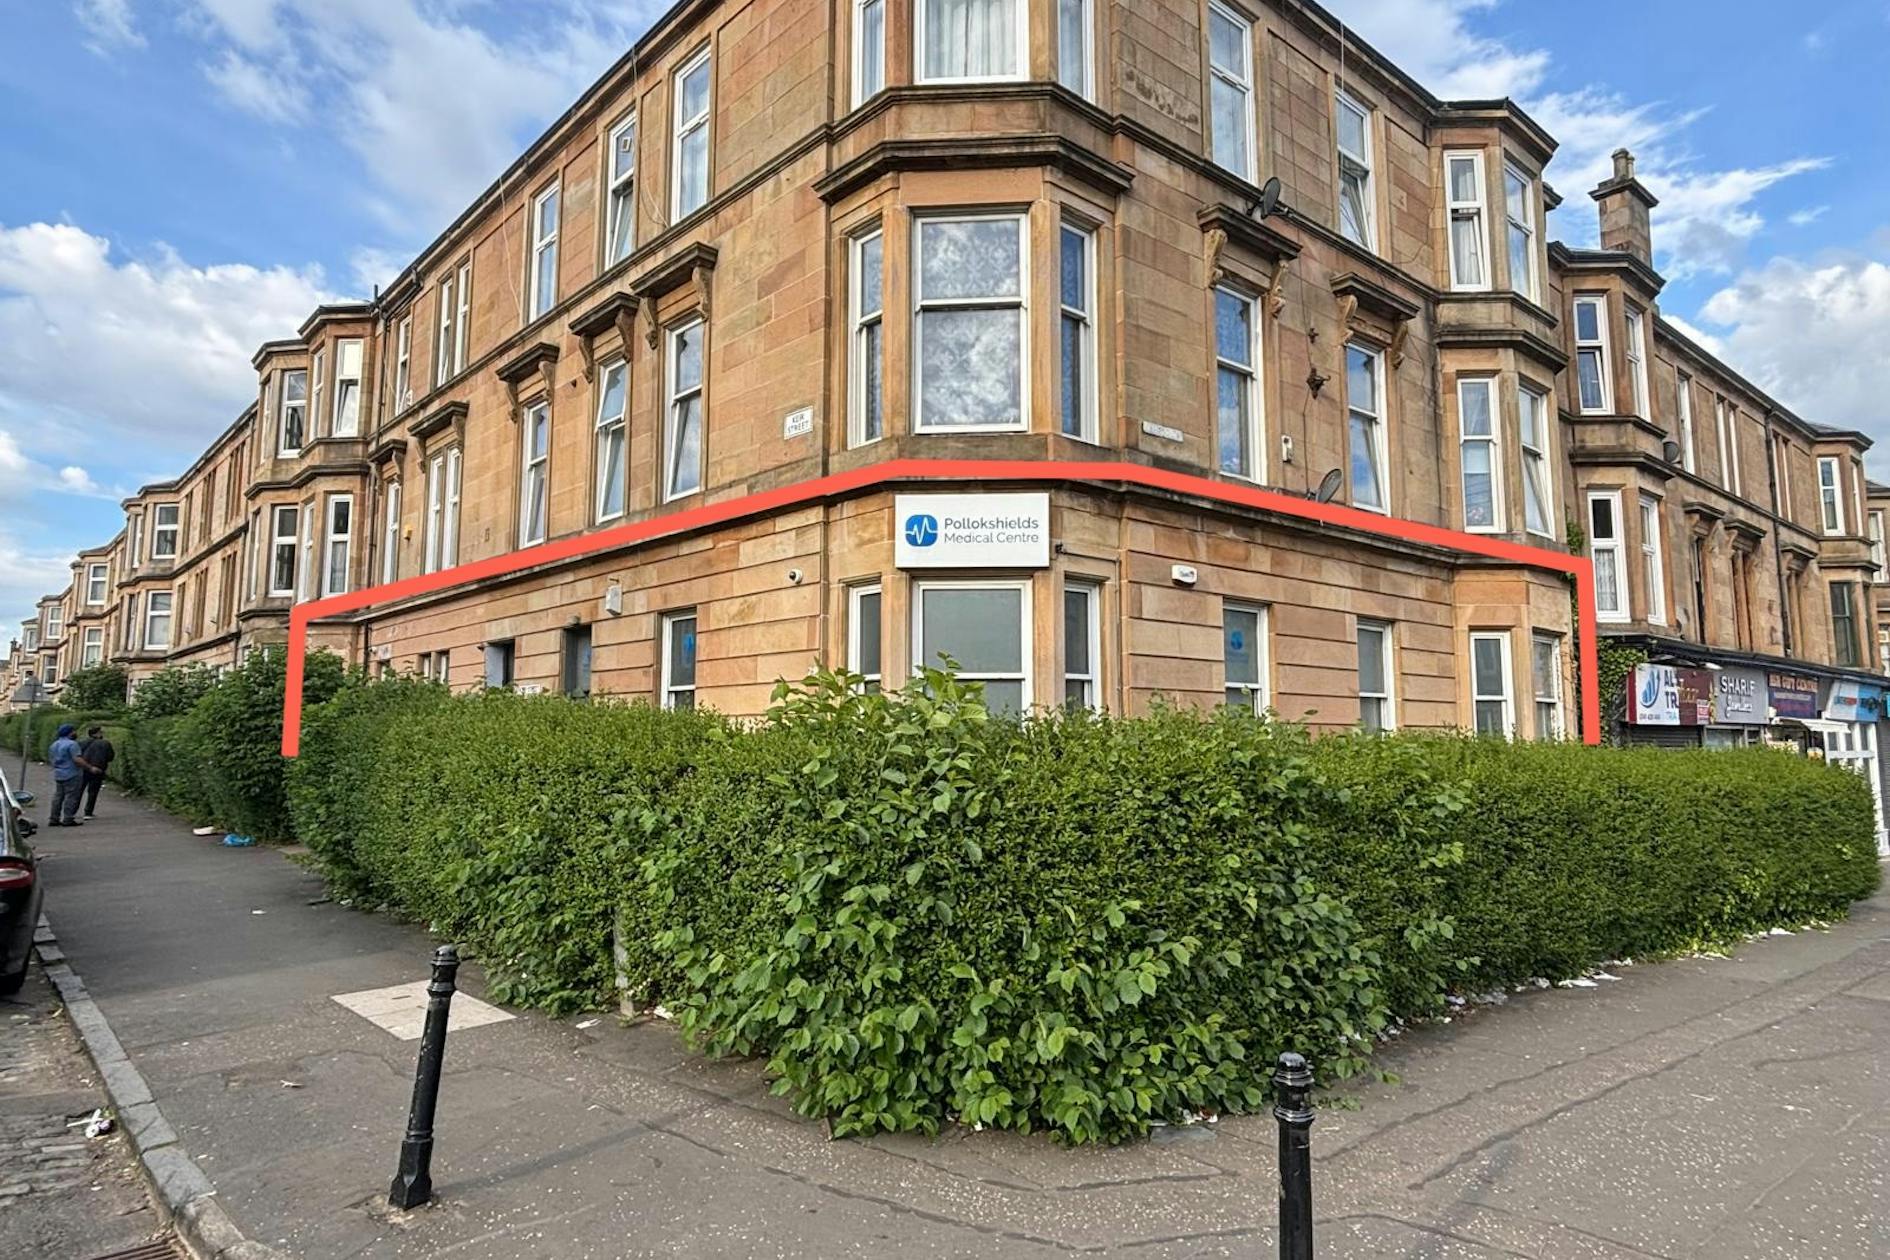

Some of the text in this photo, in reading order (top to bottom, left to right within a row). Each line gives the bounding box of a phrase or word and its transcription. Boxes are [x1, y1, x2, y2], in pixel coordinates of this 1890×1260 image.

[788, 420, 809, 433] STREET
[944, 516, 1039, 529] Pollokshields
[944, 532, 1039, 543] Medical Centre
[1720, 675, 1755, 697] SHARIF
